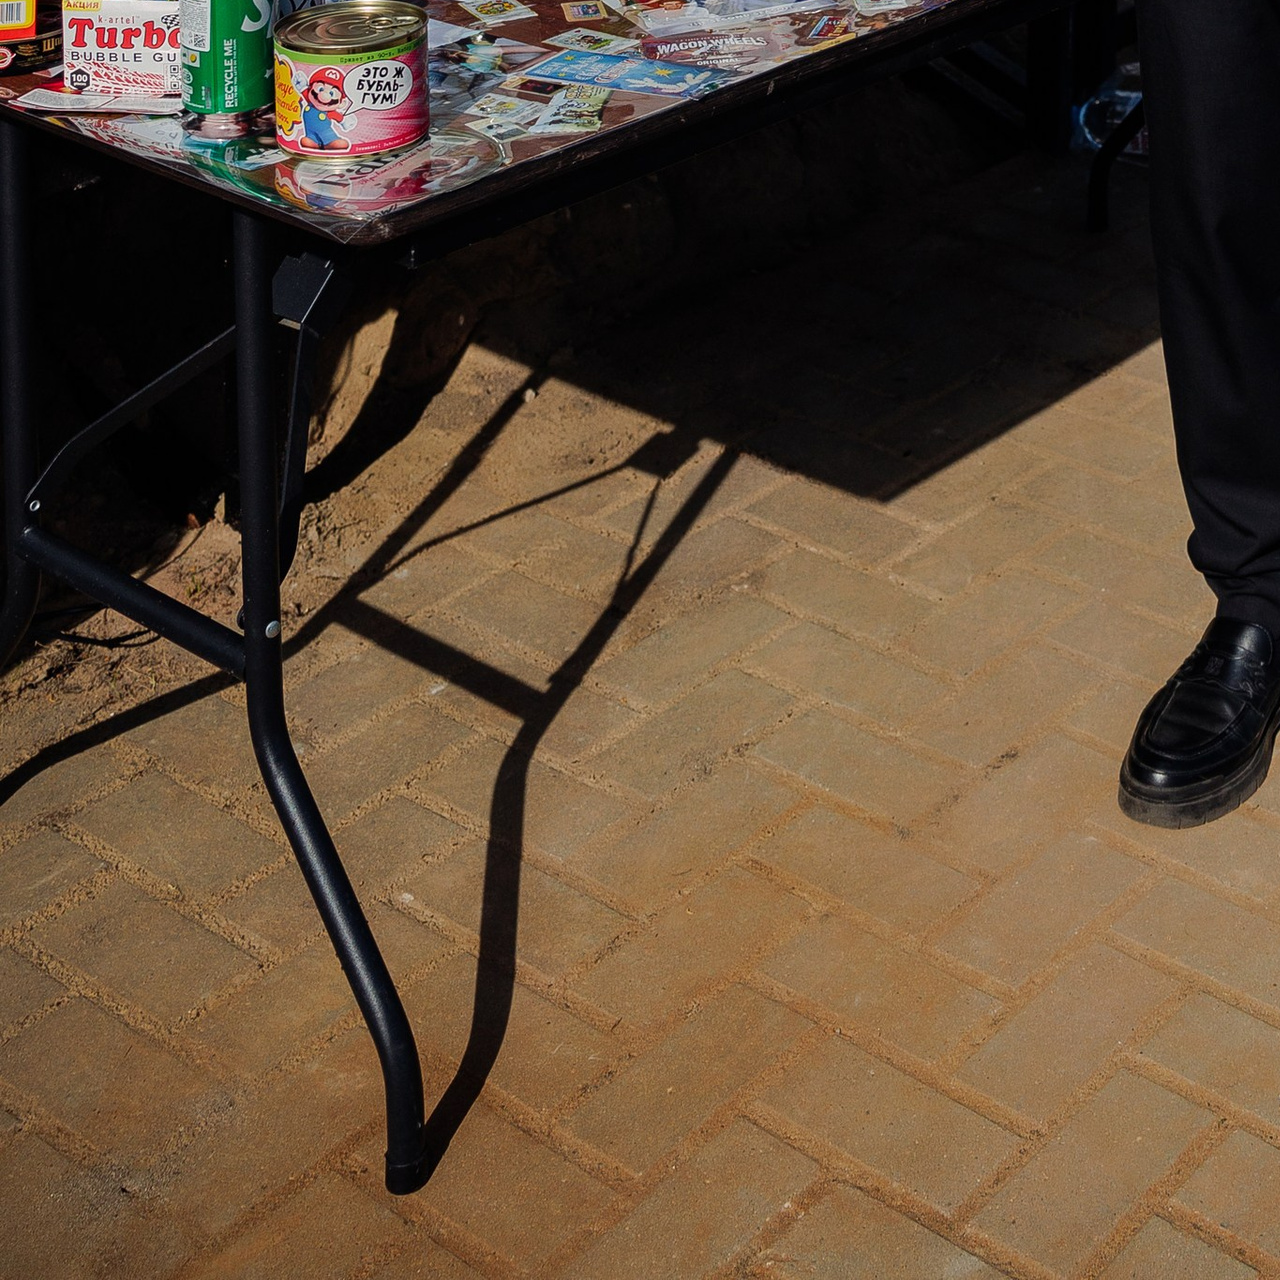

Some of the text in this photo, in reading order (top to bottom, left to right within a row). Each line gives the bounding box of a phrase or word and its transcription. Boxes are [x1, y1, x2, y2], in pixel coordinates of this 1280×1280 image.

[65, 1, 99, 9] АКЦИЯ
[98, 15, 136, 24] k-artel
[657, 36, 768, 55] WAGON WHEELS
[71, 51, 180, 63] BUBBLE GU
[697, 57, 740, 66] ORIGINAL
[72, 73, 88, 82] 100
[223, 38, 234, 108] RECYCLE ME
[362, 66, 405, 80] ЭТО Ж
[356, 79, 405, 92] БУБЛЬ-
[361, 92, 397, 105] ГУМ!
